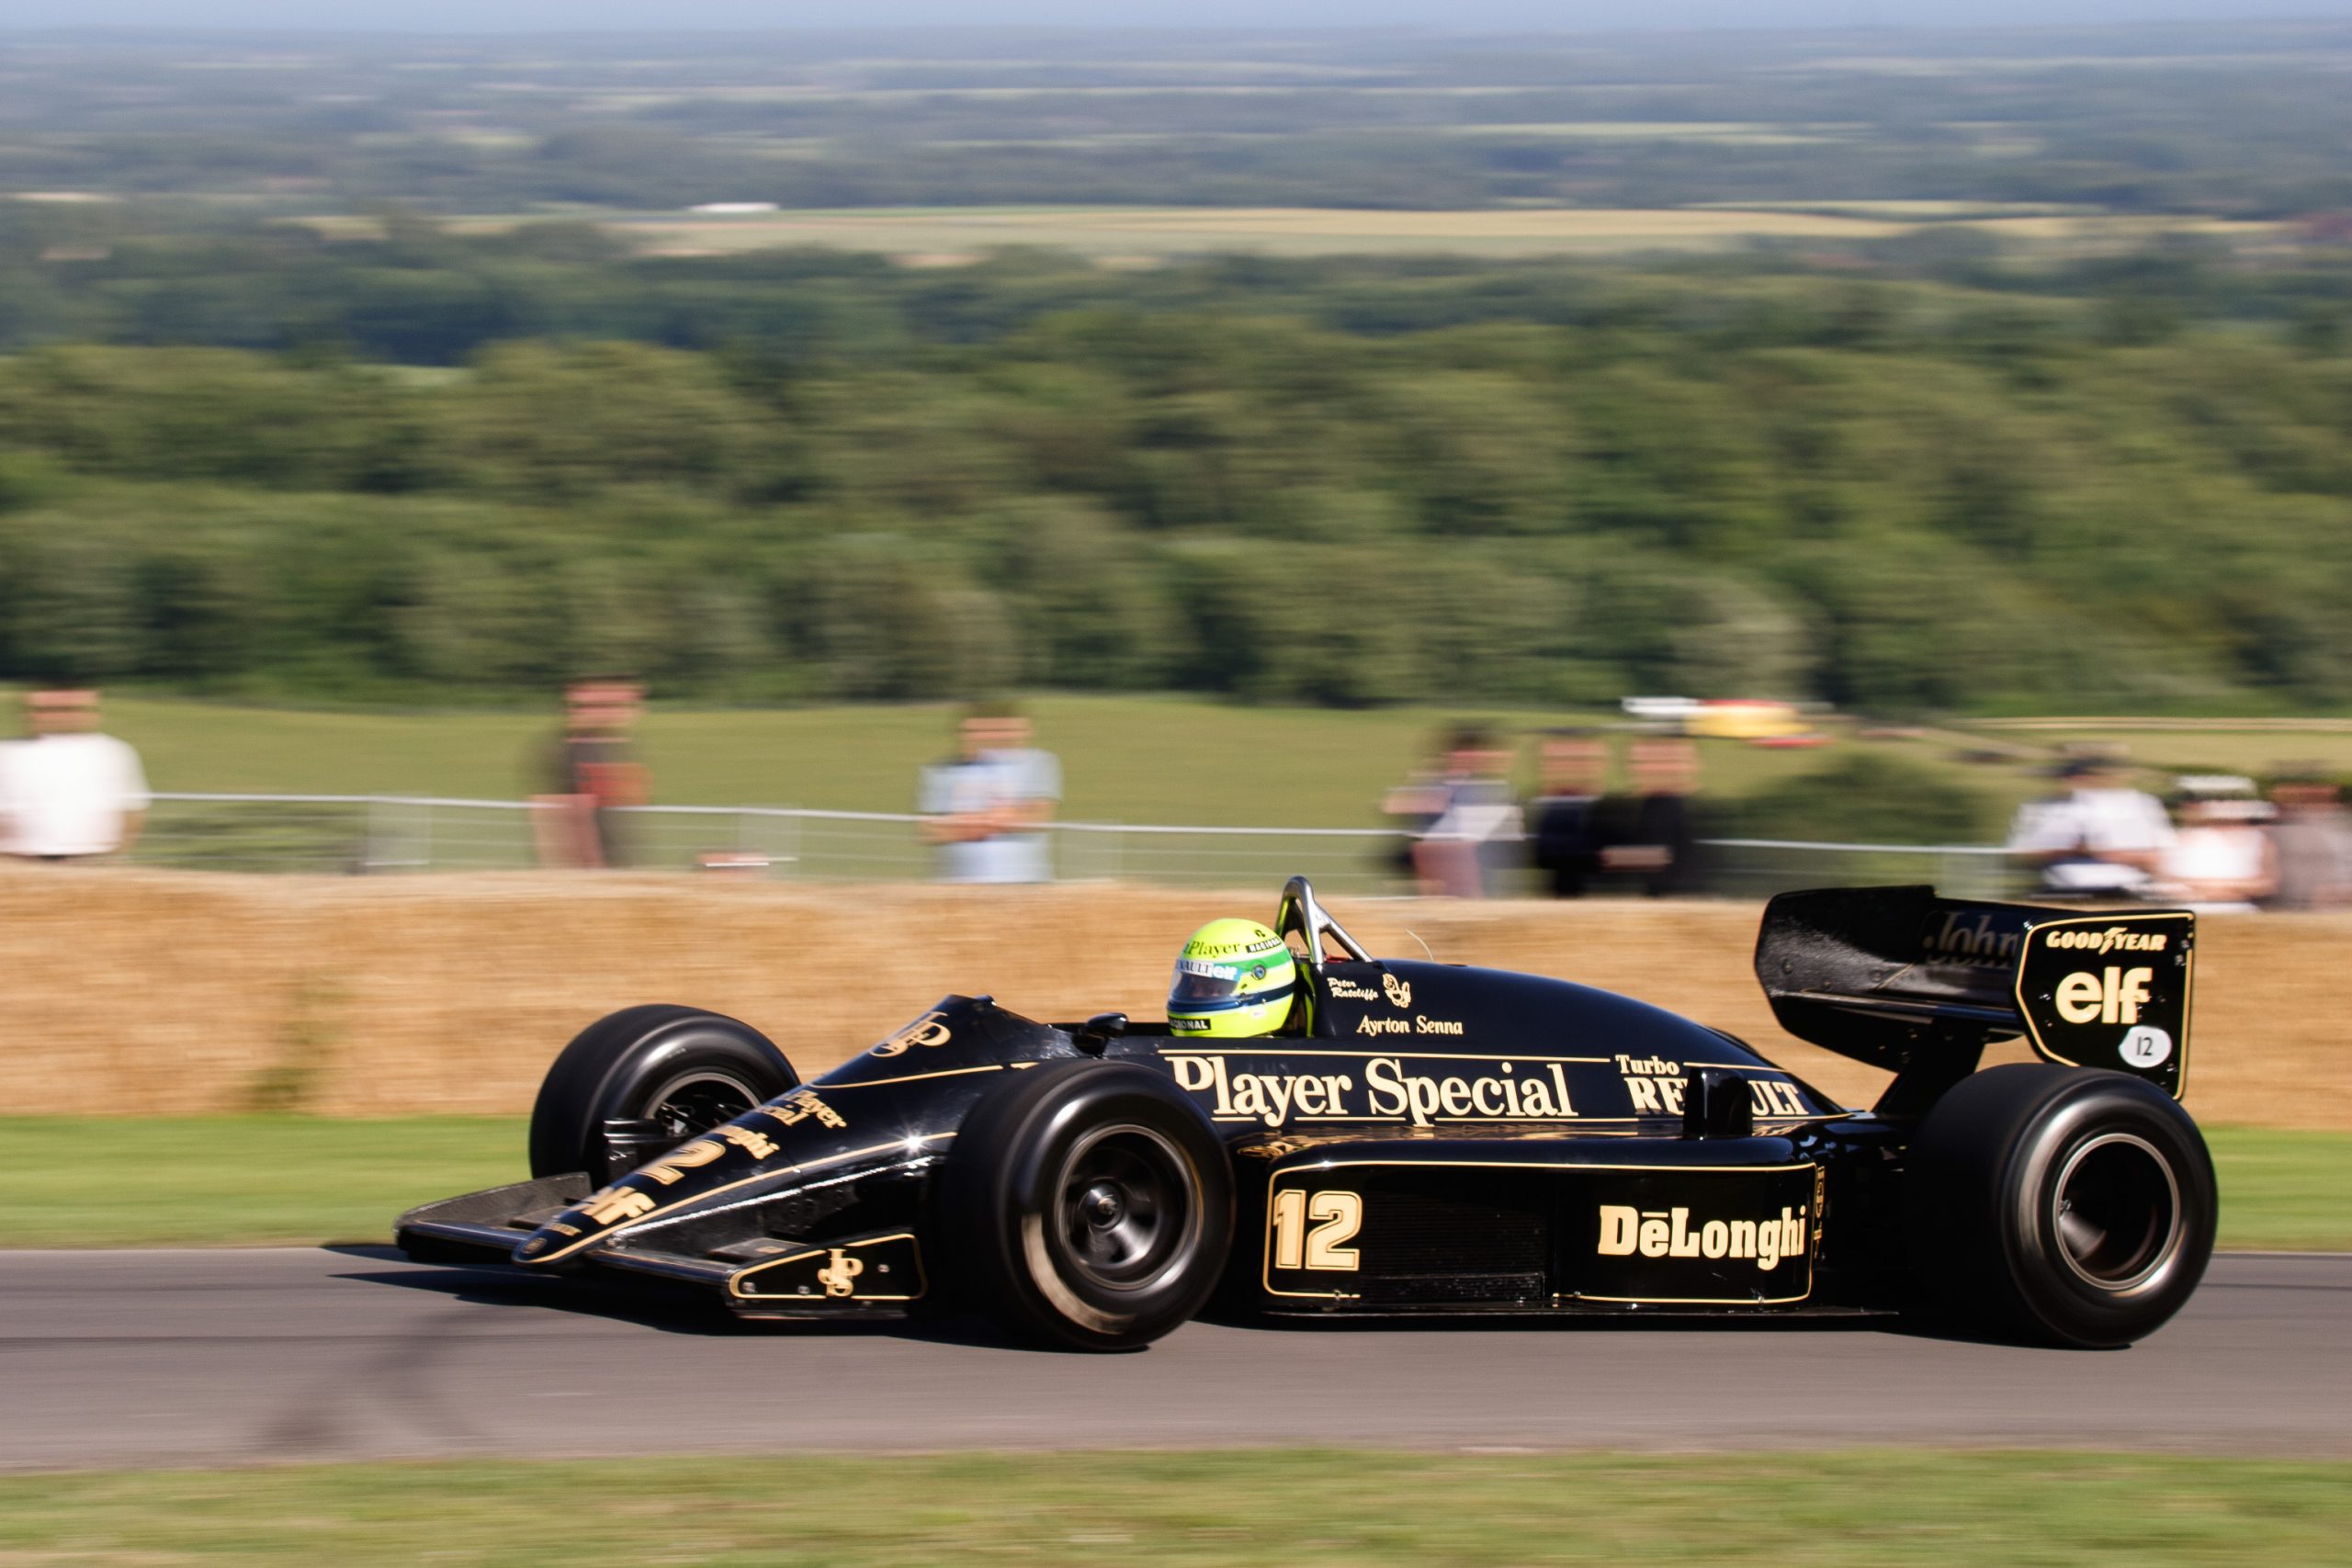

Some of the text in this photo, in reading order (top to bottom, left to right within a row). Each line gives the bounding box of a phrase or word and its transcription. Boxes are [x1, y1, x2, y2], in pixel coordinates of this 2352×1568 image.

[2046, 927, 2166, 955] GOODYEAR
[1327, 976, 1357, 988] Peter
[2055, 966, 2153, 1024] elf
[1356, 1014, 1464, 1037] Ayrton Senna
[2136, 1036, 2153, 1056] 12
[1615, 1055, 1680, 1076] Turbo
[1164, 1055, 1579, 1128] Player Special
[1273, 1189, 1363, 1271] 12
